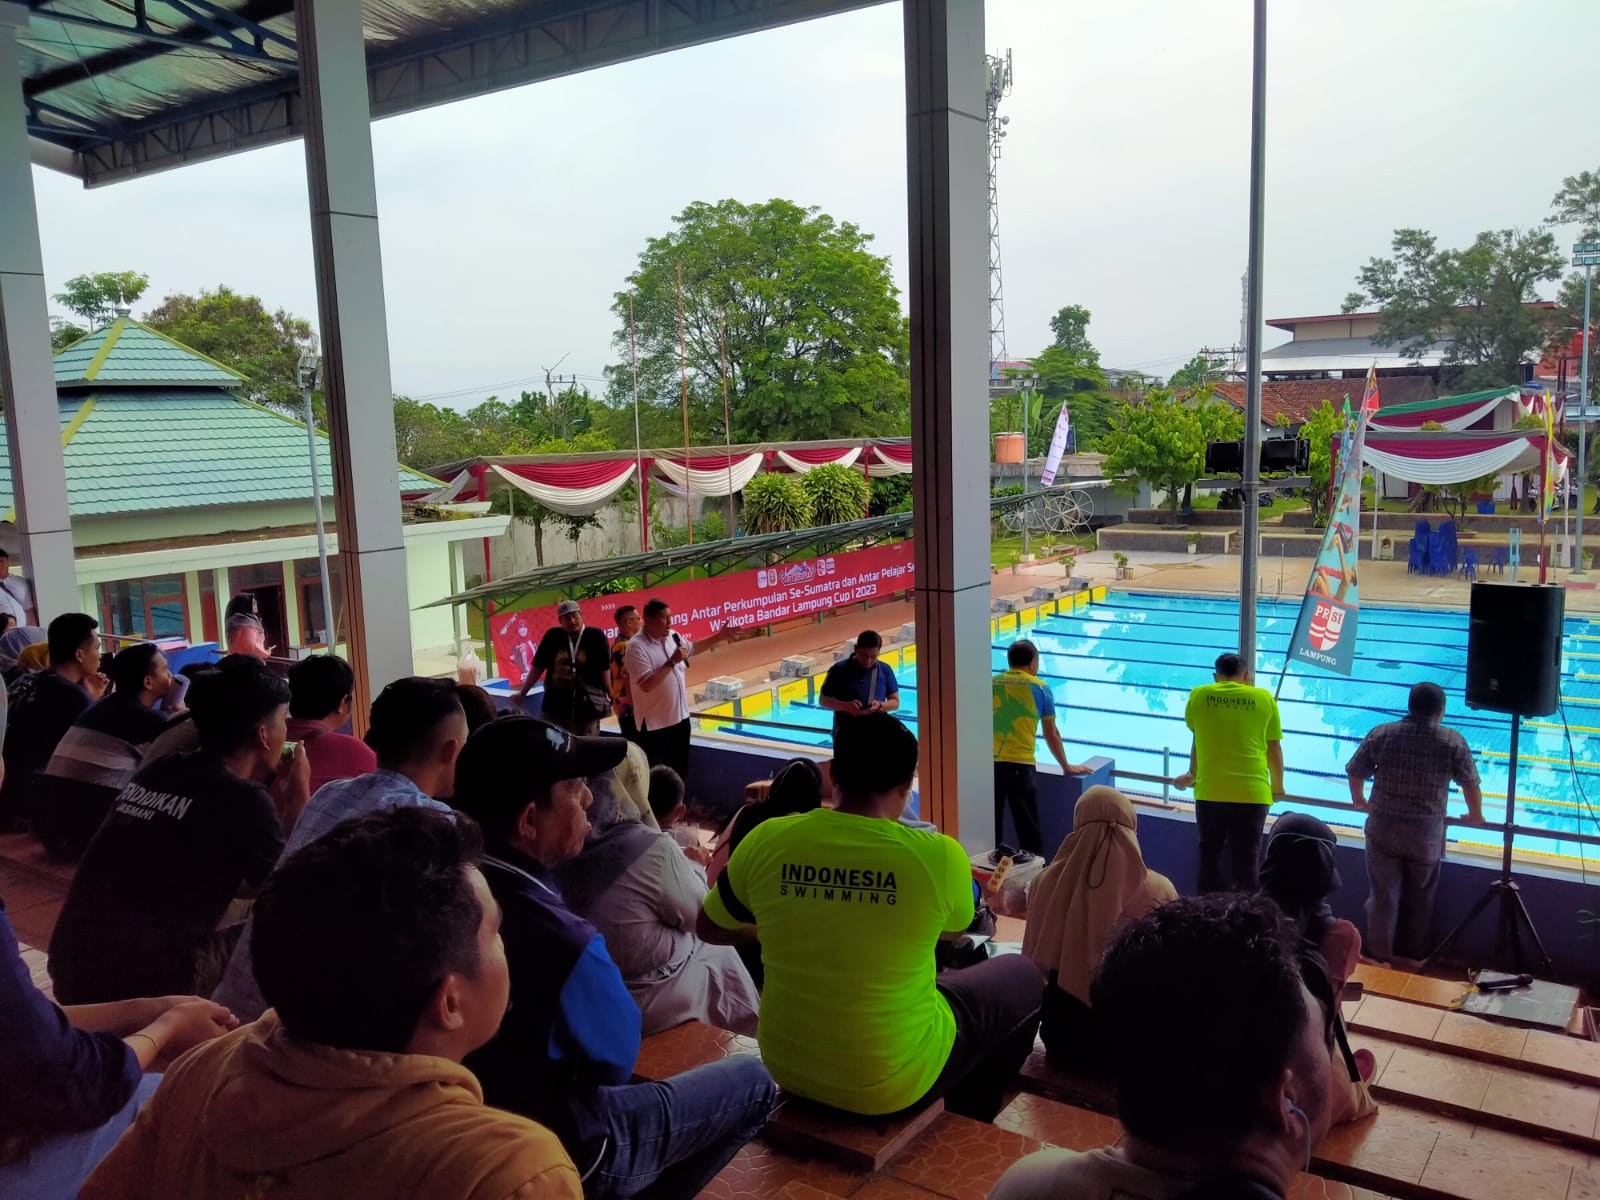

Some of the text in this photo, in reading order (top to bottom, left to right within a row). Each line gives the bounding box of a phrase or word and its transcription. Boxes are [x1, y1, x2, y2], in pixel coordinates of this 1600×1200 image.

[691, 606, 721, 622] Antar
[724, 591, 787, 613] Perkumpulan
[789, 581, 841, 599] Se-Sumatra
[842, 576, 857, 588] dan
[858, 571, 880, 584] Antar
[881, 565, 906, 579] Pelajar
[757, 605, 790, 622] Bandar
[792, 596, 832, 613] Lampung
[834, 591, 850, 603] Cup
[855, 584, 877, 598] 2023
[1315, 606, 1343, 625] PRSI
[1299, 648, 1337, 666] LAMPUNG
[1206, 695, 1256, 705] INDONESIA
[782, 863, 897, 889] INDONESIA
[780, 885, 897, 905] SWIMMING
